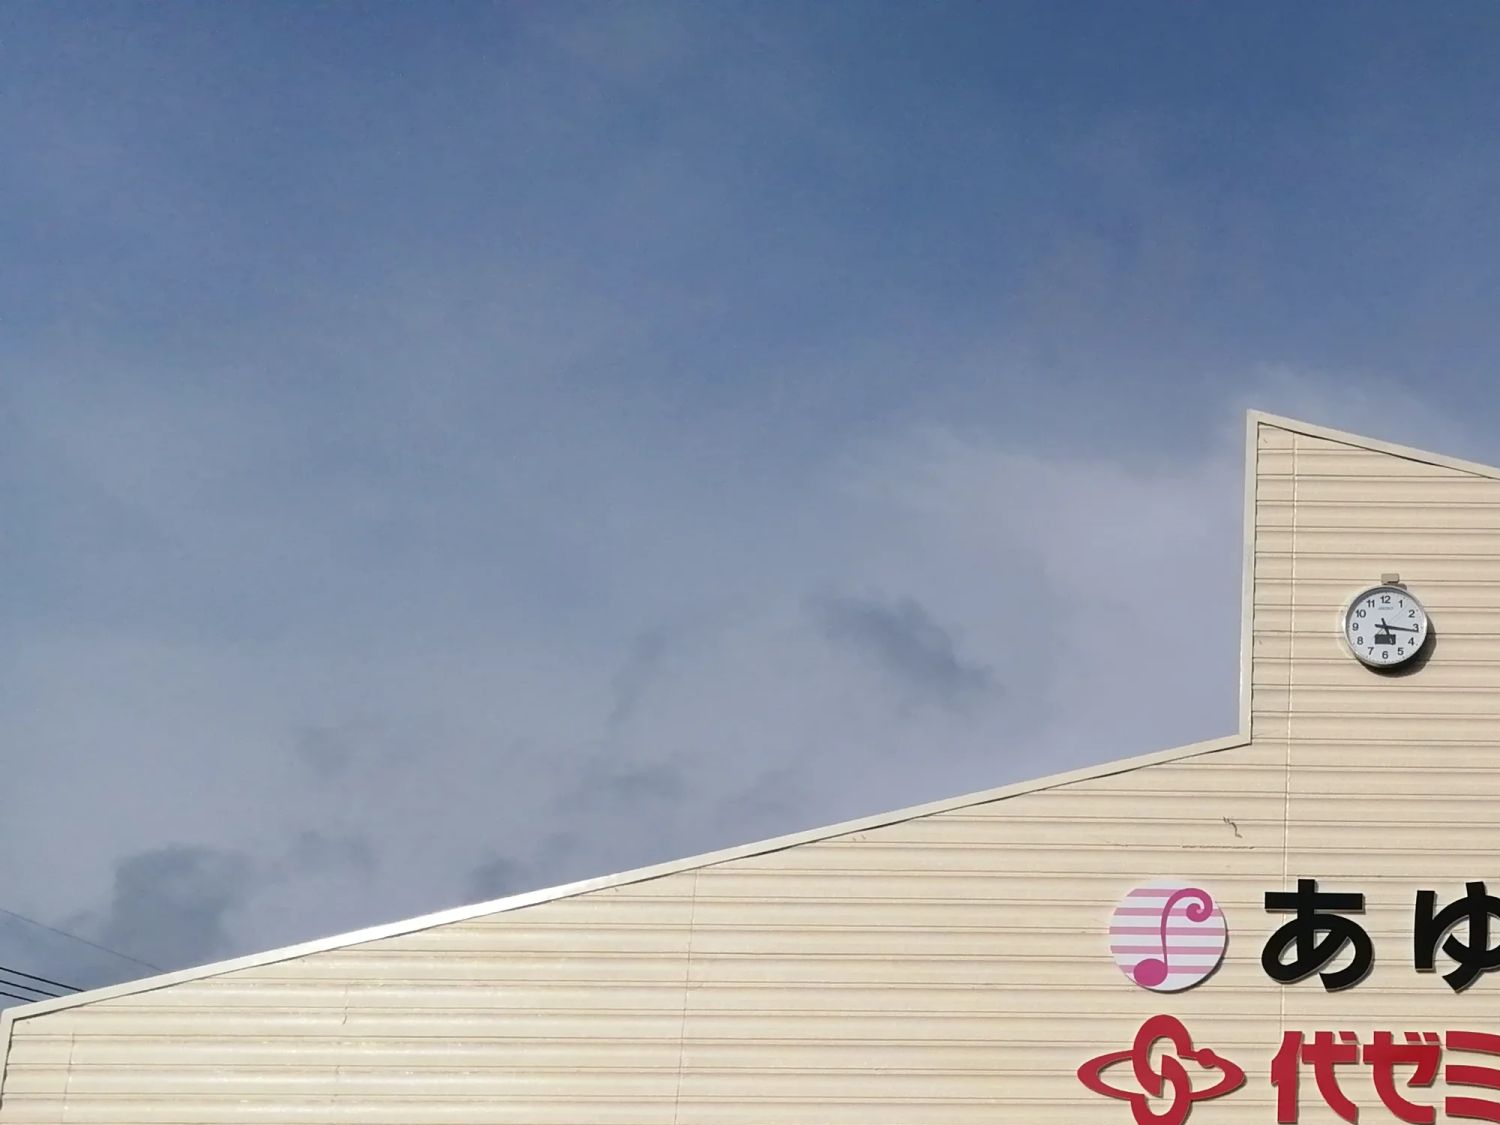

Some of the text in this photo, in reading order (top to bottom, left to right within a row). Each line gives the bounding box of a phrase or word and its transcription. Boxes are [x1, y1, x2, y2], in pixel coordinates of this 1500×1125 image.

[1366, 599, 1375, 608] 11
[1380, 595, 1391, 604] 12
[1356, 609, 1366, 618] 10
[1408, 609, 1416, 618] 2
[1352, 623, 1359, 631] 9
[1413, 624, 1419, 632] 3
[1357, 636, 1364, 645] 8
[1408, 637, 1415, 646] 4
[1367, 647, 1374, 655] 7
[1382, 651, 1389, 660] 6
[1397, 647, 1404, 656] 5
